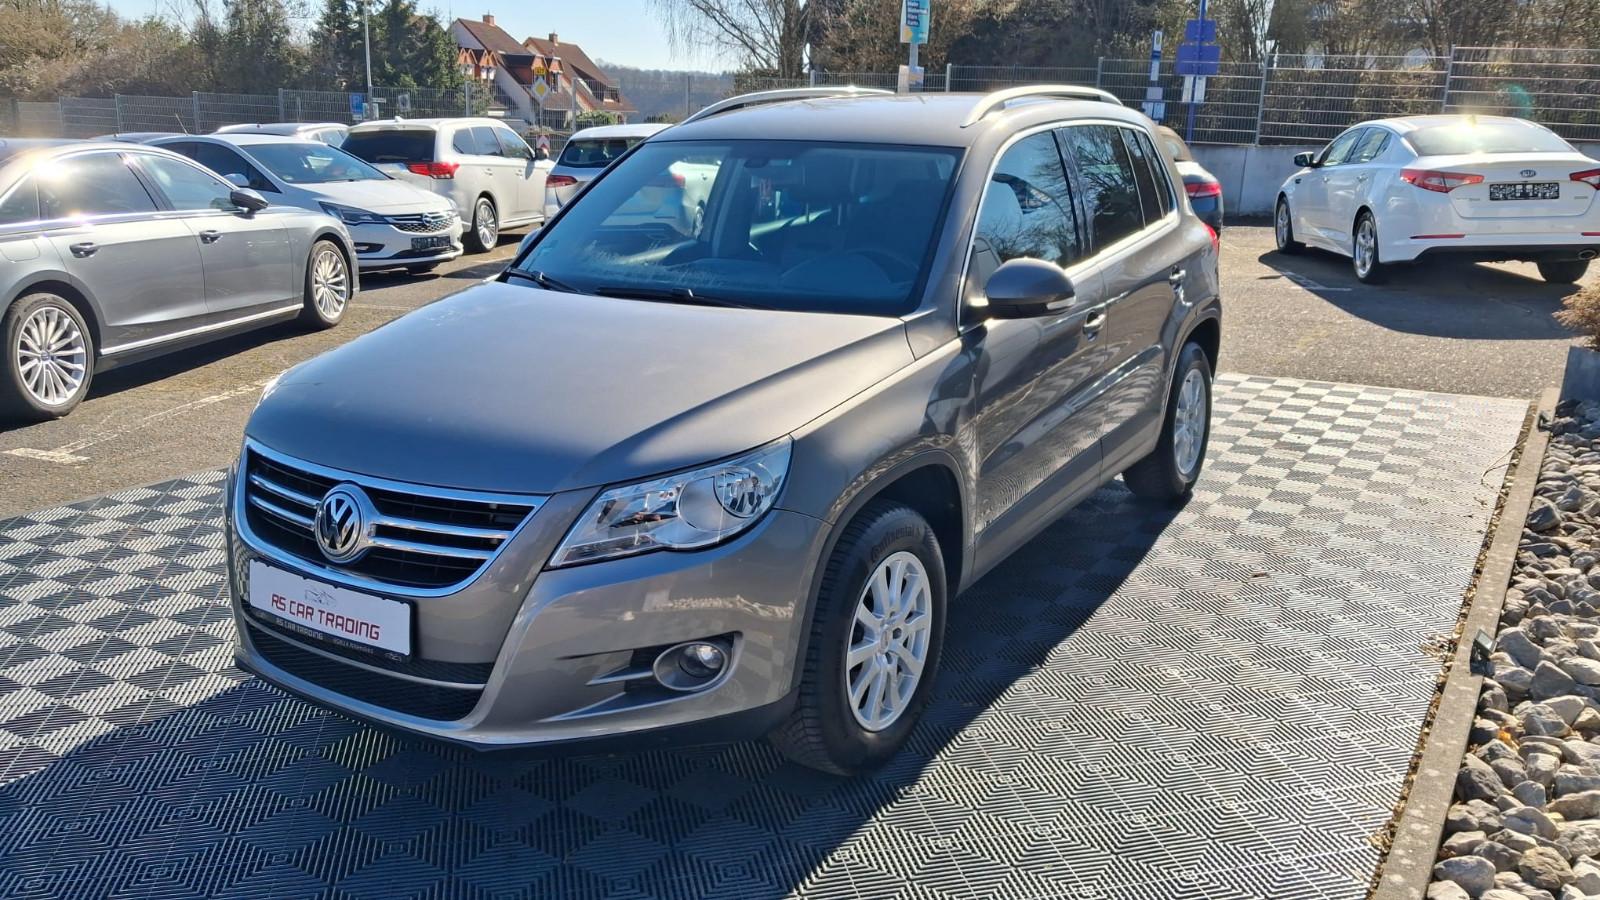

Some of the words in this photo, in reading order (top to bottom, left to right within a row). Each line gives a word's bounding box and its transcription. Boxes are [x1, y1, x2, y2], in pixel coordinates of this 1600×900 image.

[271, 593, 286, 611] RS
[289, 600, 315, 621] CAR
[317, 609, 381, 641] TRADING
[284, 620, 296, 631] CAR
[297, 624, 324, 641] TRADING
